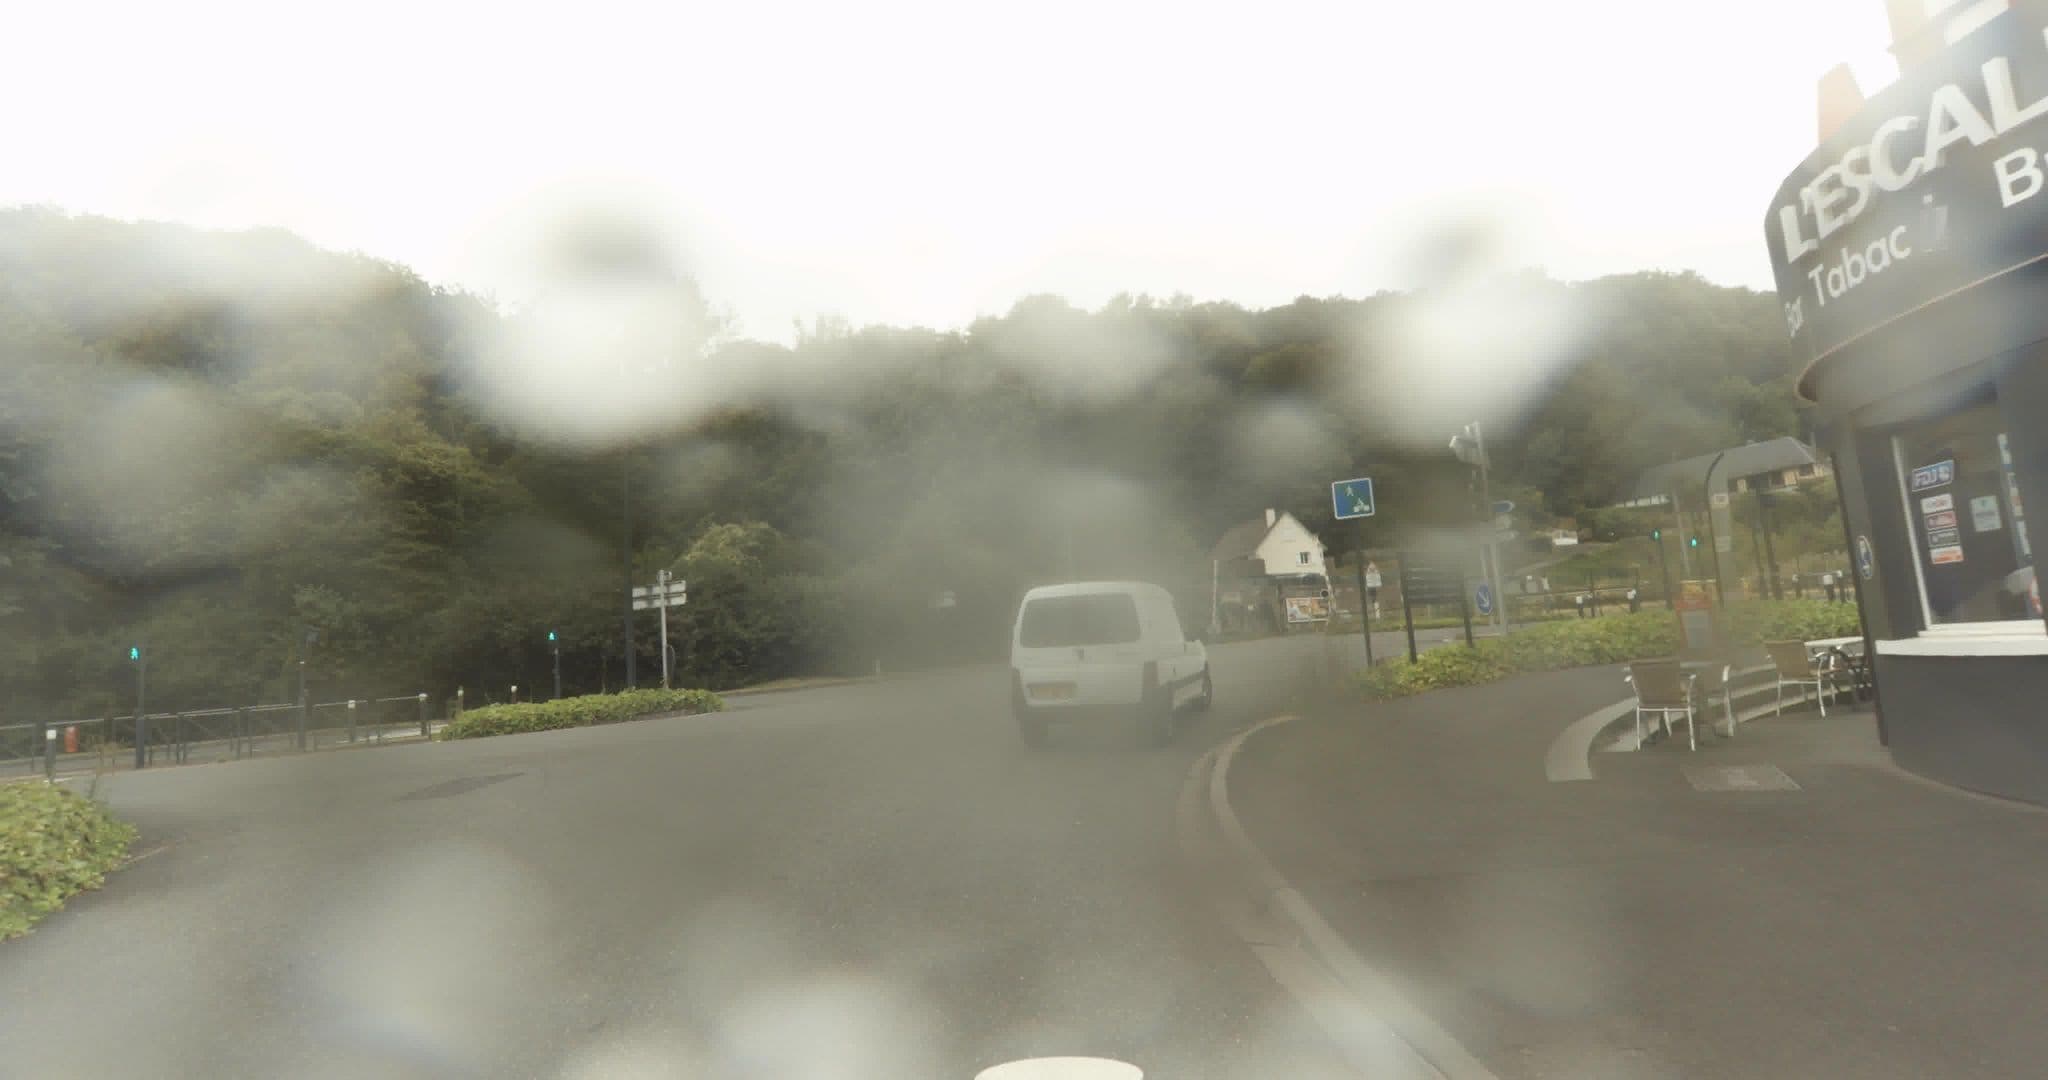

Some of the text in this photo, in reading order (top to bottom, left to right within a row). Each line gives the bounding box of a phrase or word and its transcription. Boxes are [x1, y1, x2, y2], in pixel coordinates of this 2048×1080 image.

[1779, 27, 2048, 264] L'ESCAL
[1993, 147, 2048, 208] B
[1808, 225, 1912, 306] Tabac
